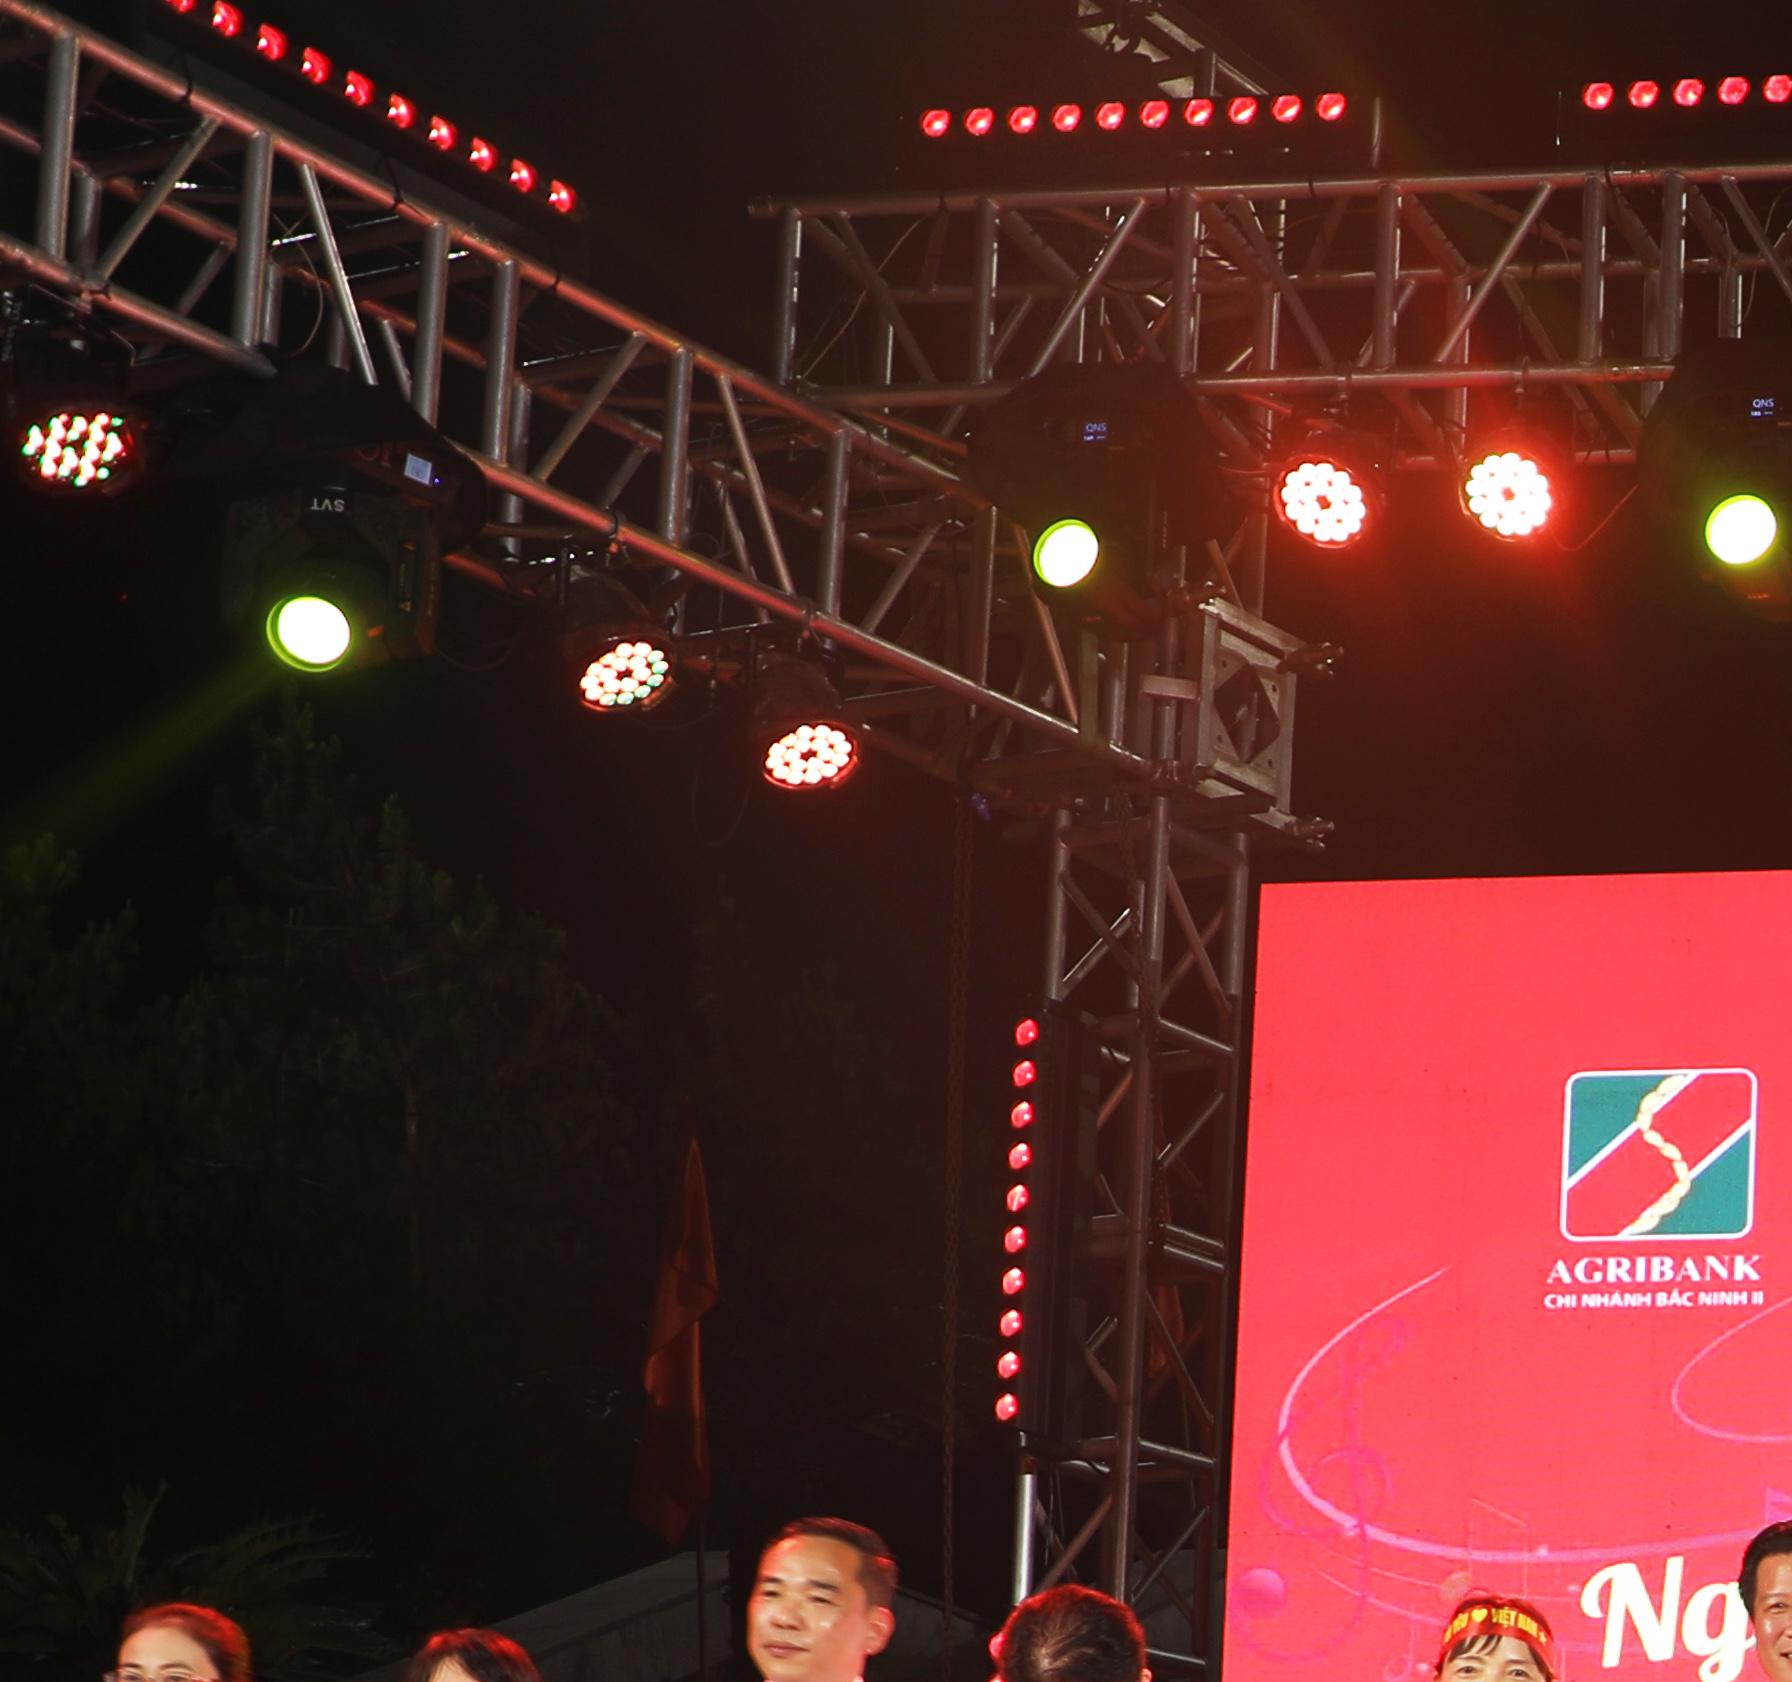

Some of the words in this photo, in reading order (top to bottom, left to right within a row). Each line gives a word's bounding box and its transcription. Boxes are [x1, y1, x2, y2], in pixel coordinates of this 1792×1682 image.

[310, 498, 345, 512] SVT
[1546, 1255, 1764, 1283] AGRIBANK
[1544, 1294, 1576, 1309] CHI
[1581, 1290, 1651, 1308] NHÁNH
[1655, 1288, 1694, 1307] BẮC
[1698, 1291, 1747, 1305] NINH
[1751, 1291, 1763, 1305] II
[1492, 1607, 1517, 1628] VIỆT
[1517, 1613, 1538, 1638] NAM
